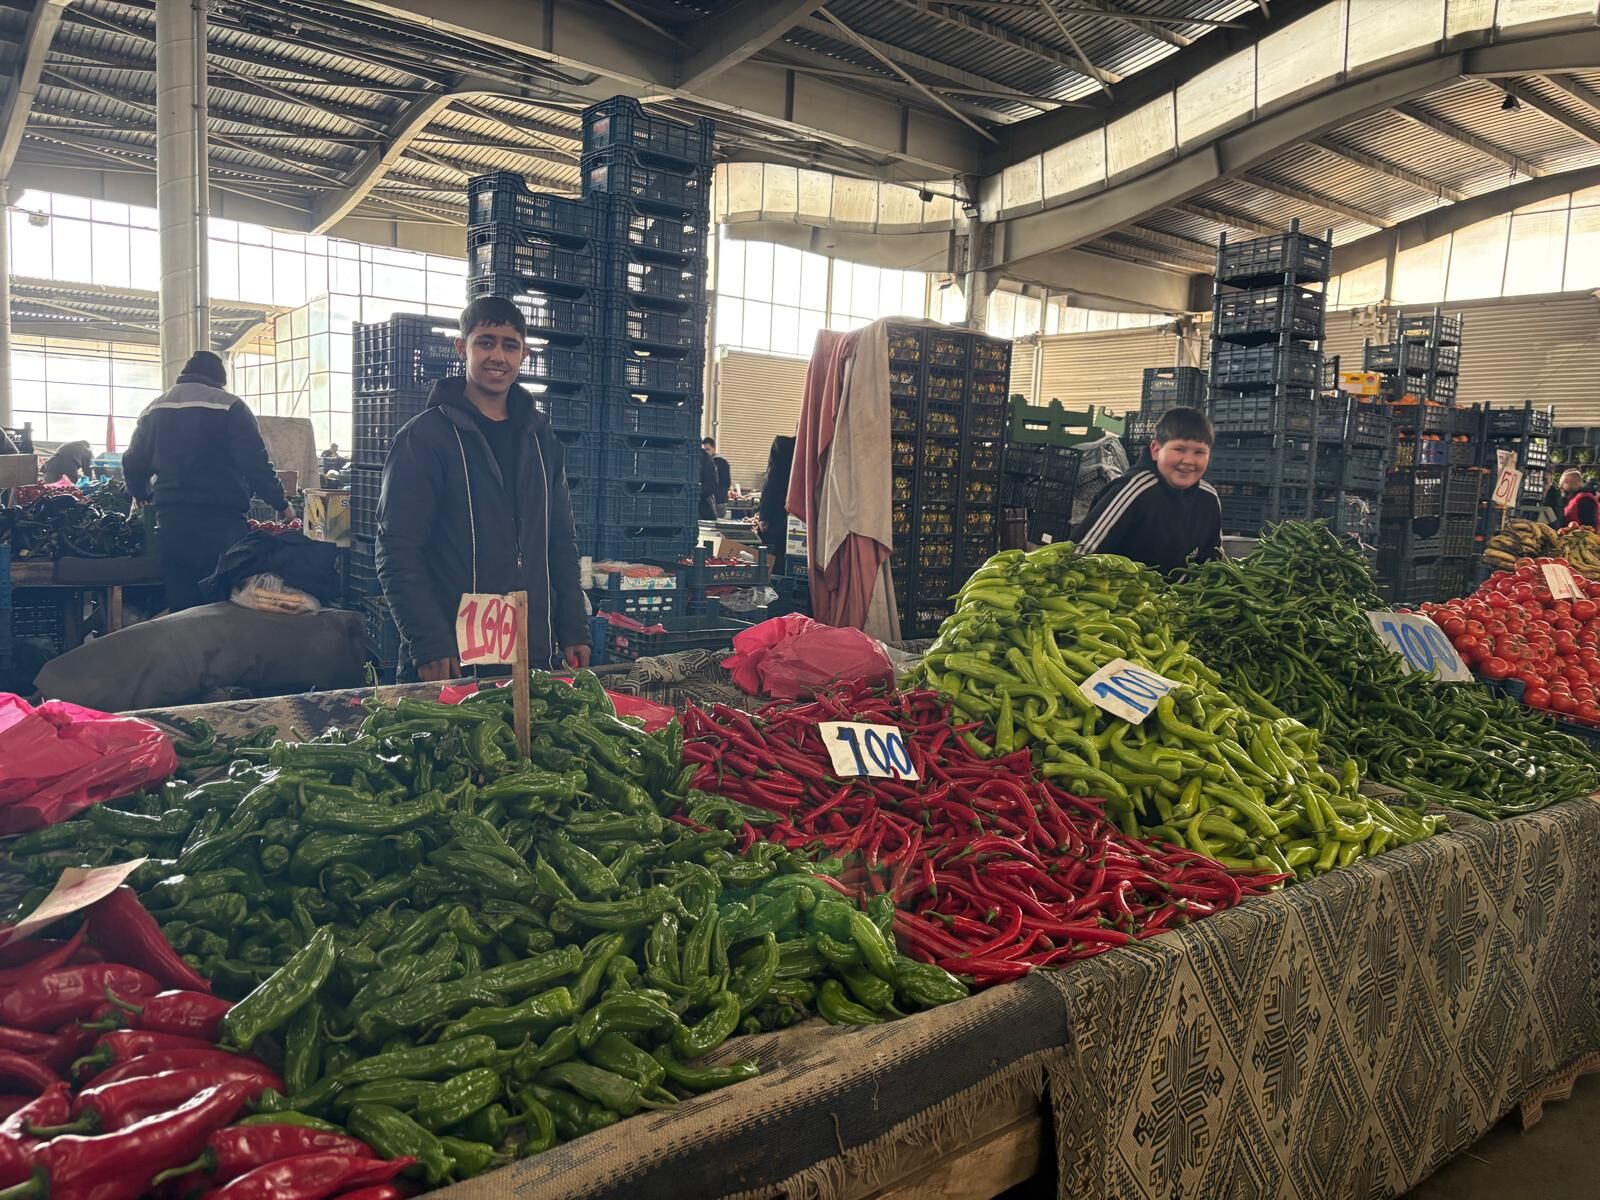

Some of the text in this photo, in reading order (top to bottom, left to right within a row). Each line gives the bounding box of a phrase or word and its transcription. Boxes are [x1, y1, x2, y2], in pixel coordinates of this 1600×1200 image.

[459, 598, 517, 661] 100
[1382, 621, 1458, 673] 100
[1093, 669, 1169, 715] 100
[836, 726, 913, 776] 100
